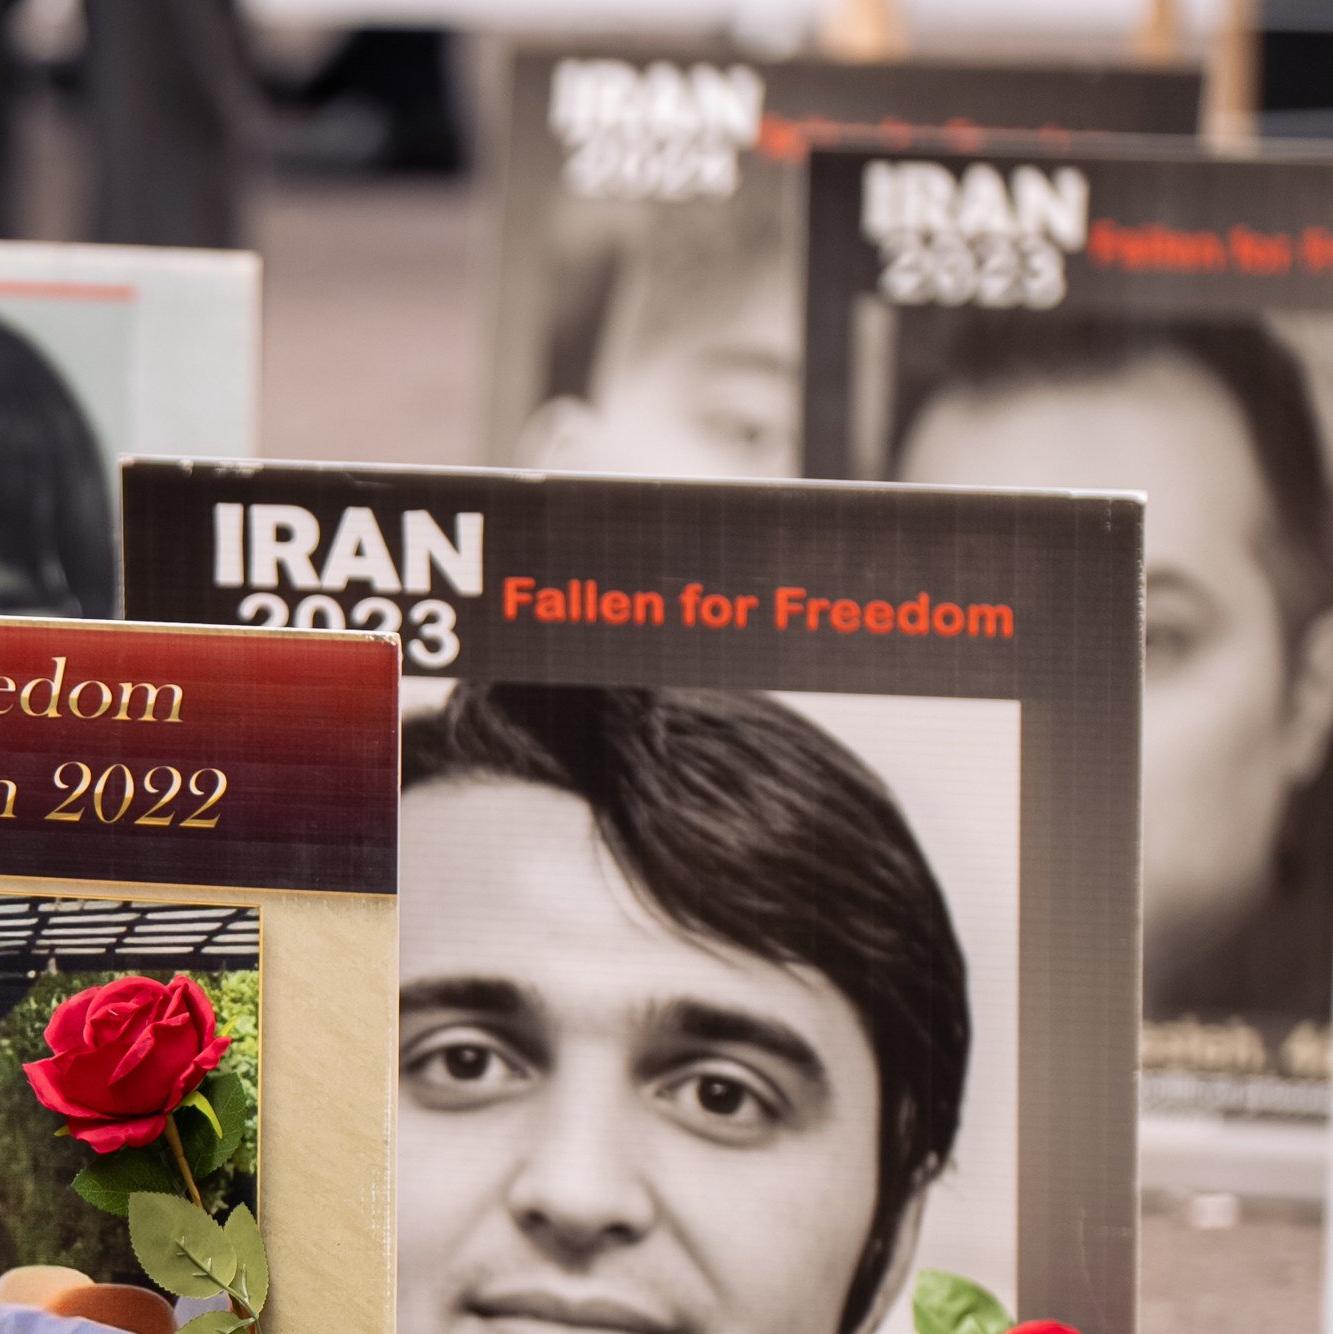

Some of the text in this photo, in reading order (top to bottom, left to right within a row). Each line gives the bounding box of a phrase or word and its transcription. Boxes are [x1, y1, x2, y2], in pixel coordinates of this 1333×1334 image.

[548, 56, 767, 147] IRAN
[861, 160, 1090, 252] IRAN
[878, 235, 1067, 310] 2023
[214, 502, 485, 597] IRAN
[502, 576, 665, 627] Fallen
[678, 582, 760, 630] for
[774, 586, 1015, 638] Freedom
[43, 761, 228, 828] 2022
